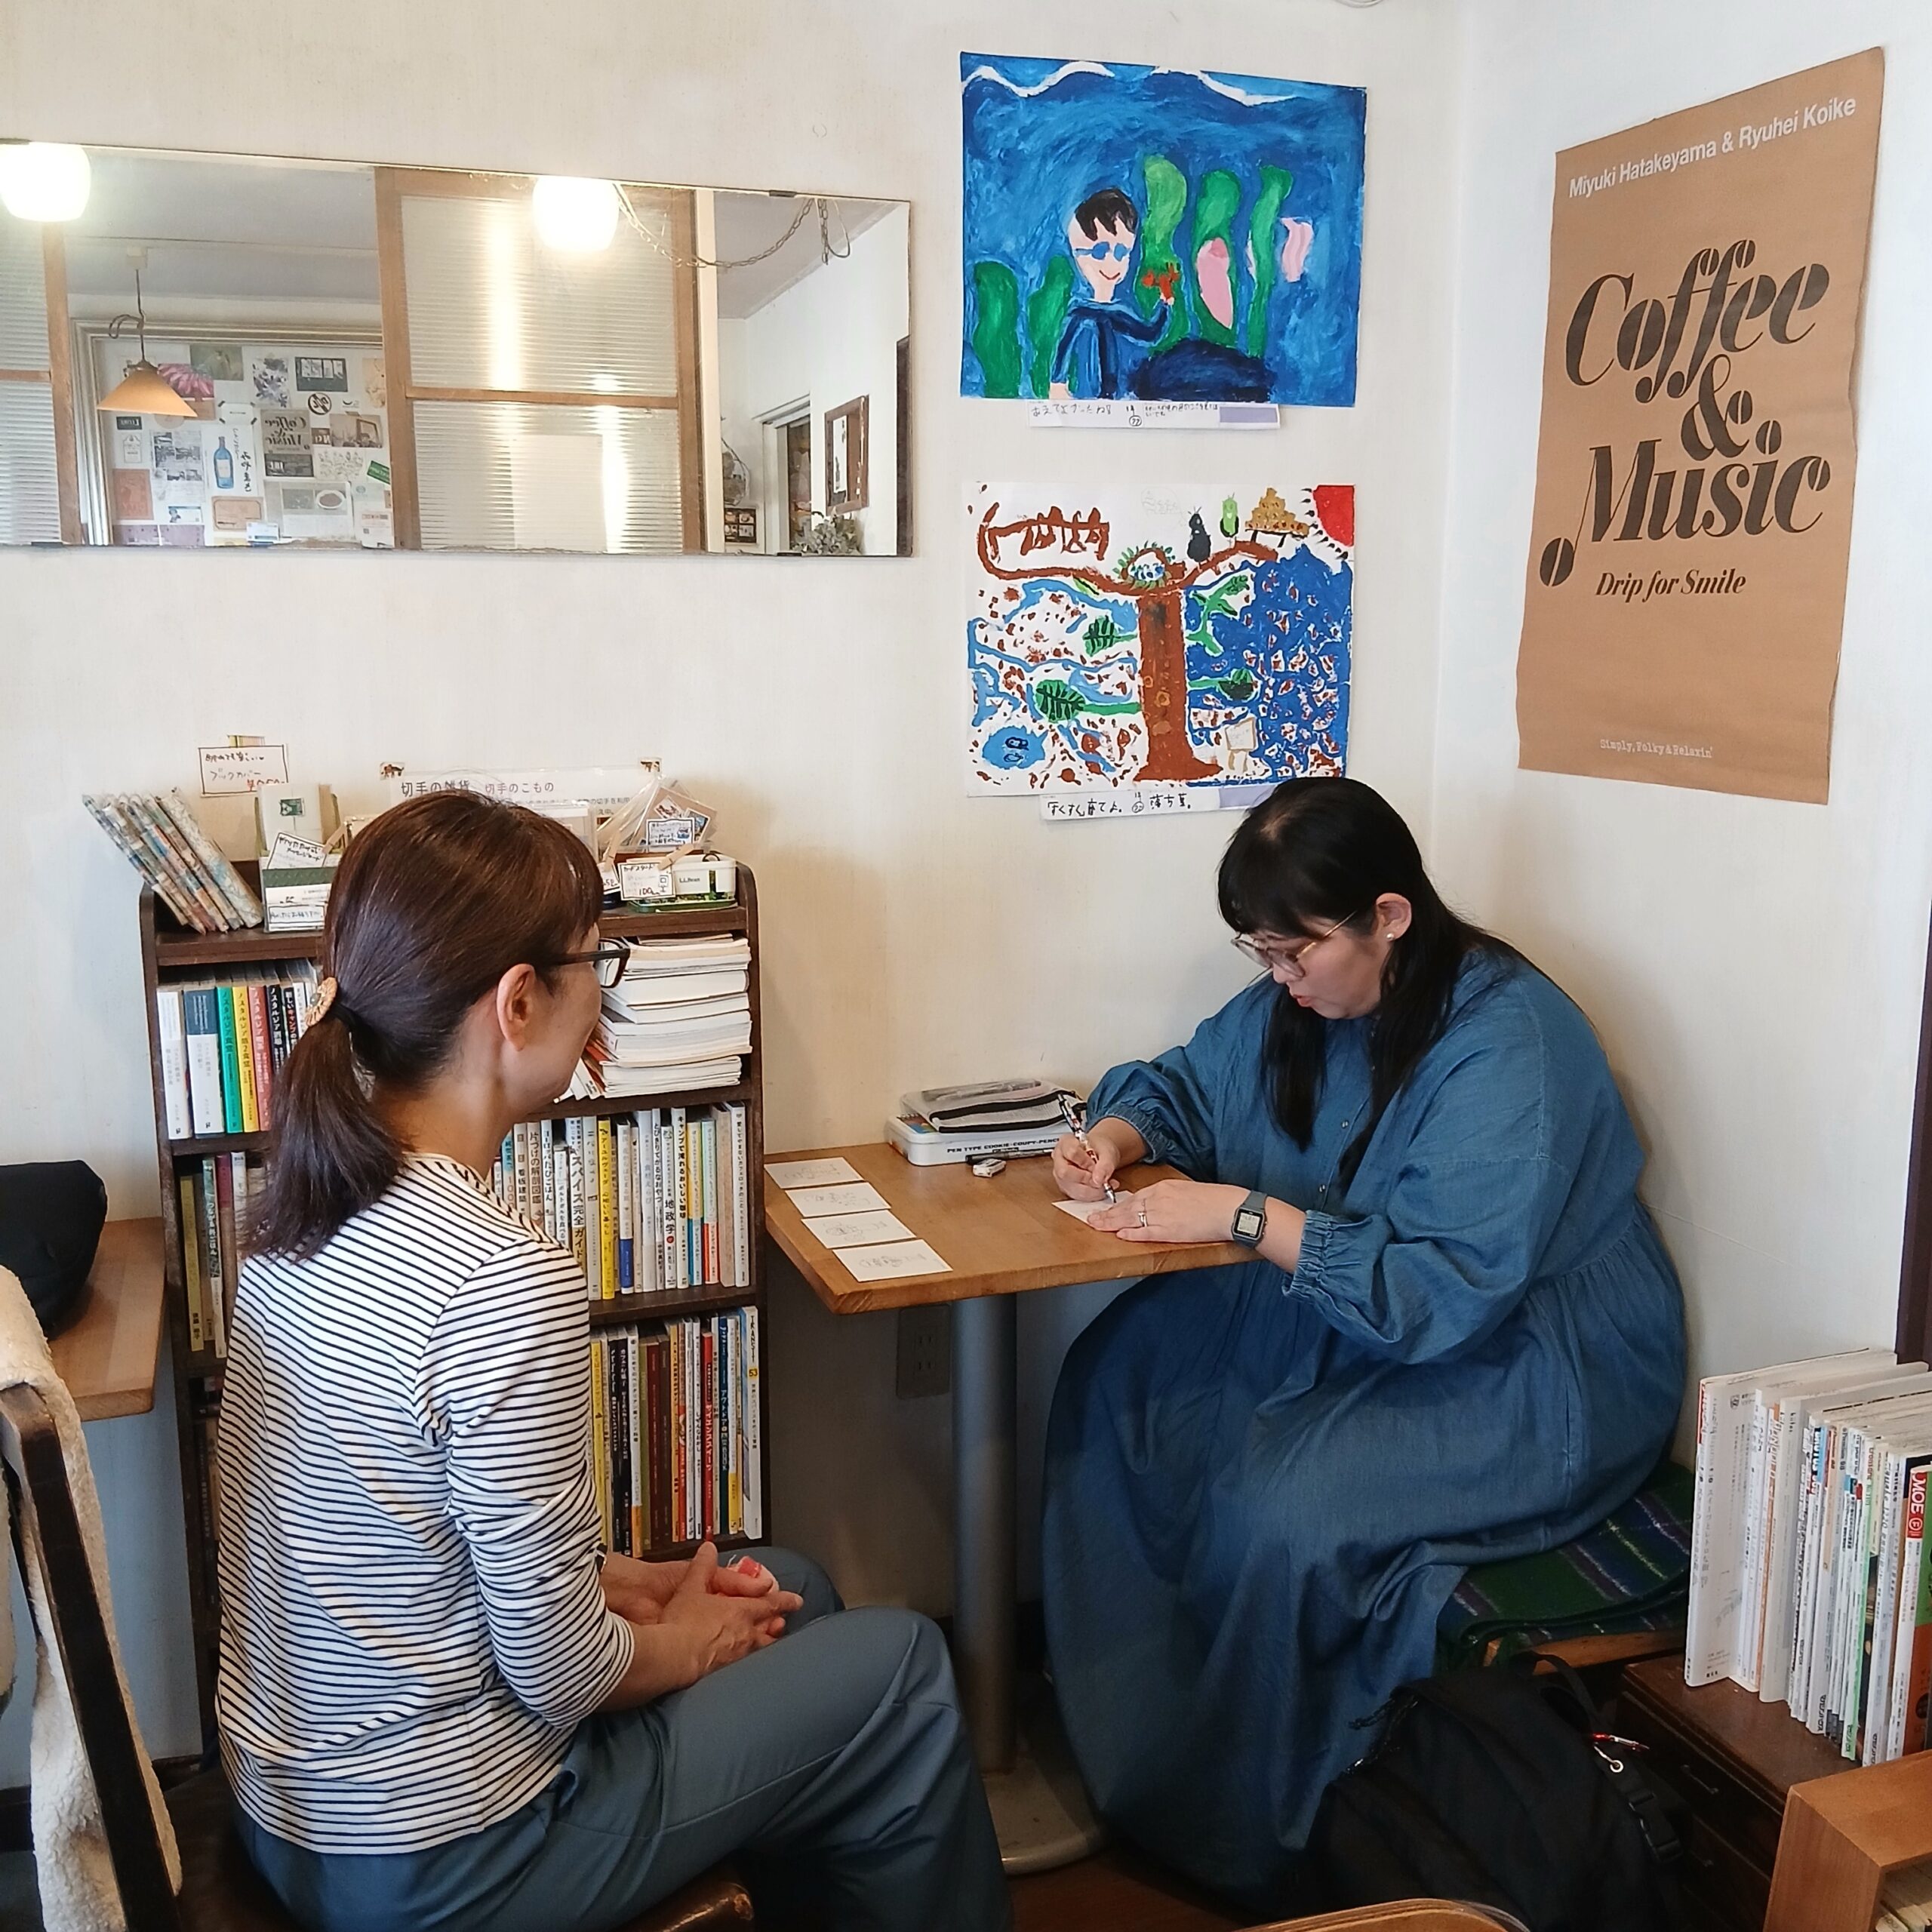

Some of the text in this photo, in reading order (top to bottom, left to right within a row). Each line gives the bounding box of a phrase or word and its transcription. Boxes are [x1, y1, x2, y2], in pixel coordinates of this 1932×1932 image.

[1569, 96, 1857, 198] Miyuki Hatakeyama & Ryuhei Koike
[1566, 239, 1830, 404] Coffee
[1681, 353, 1753, 461] &
[1540, 419, 1831, 587] Music
[1595, 568, 1746, 604] Drip for Smile
[485, 781, 555, 795] 切手のこもの
[571, 1156, 586, 1260] スパイス完全ガイド
[664, 1199, 676, 1235] 地政学
[749, 1368, 758, 1379] 53
[1910, 1472, 1927, 1515] MOE
